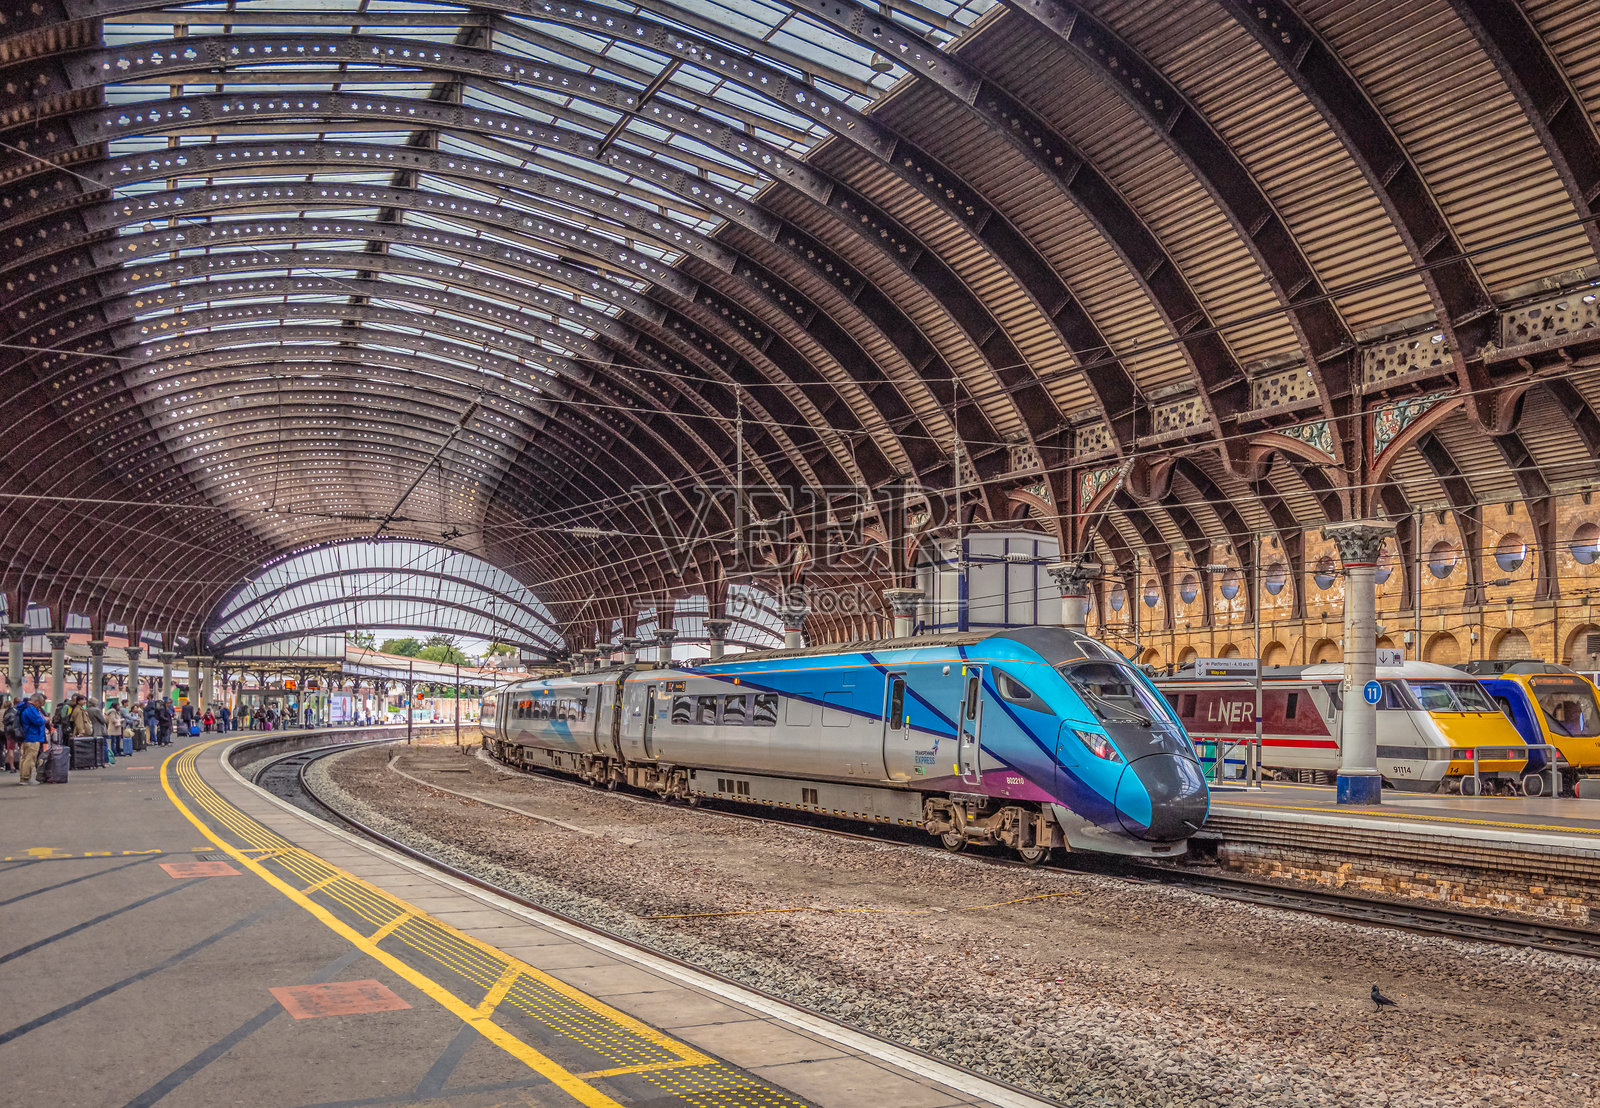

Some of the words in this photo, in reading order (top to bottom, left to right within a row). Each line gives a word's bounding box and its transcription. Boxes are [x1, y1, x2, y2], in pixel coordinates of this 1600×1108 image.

[1367, 687, 1377, 700] 11
[1208, 697, 1254, 726] LNER
[914, 756, 936, 765] EXPRESS
[1006, 776, 1024, 784] 802210
